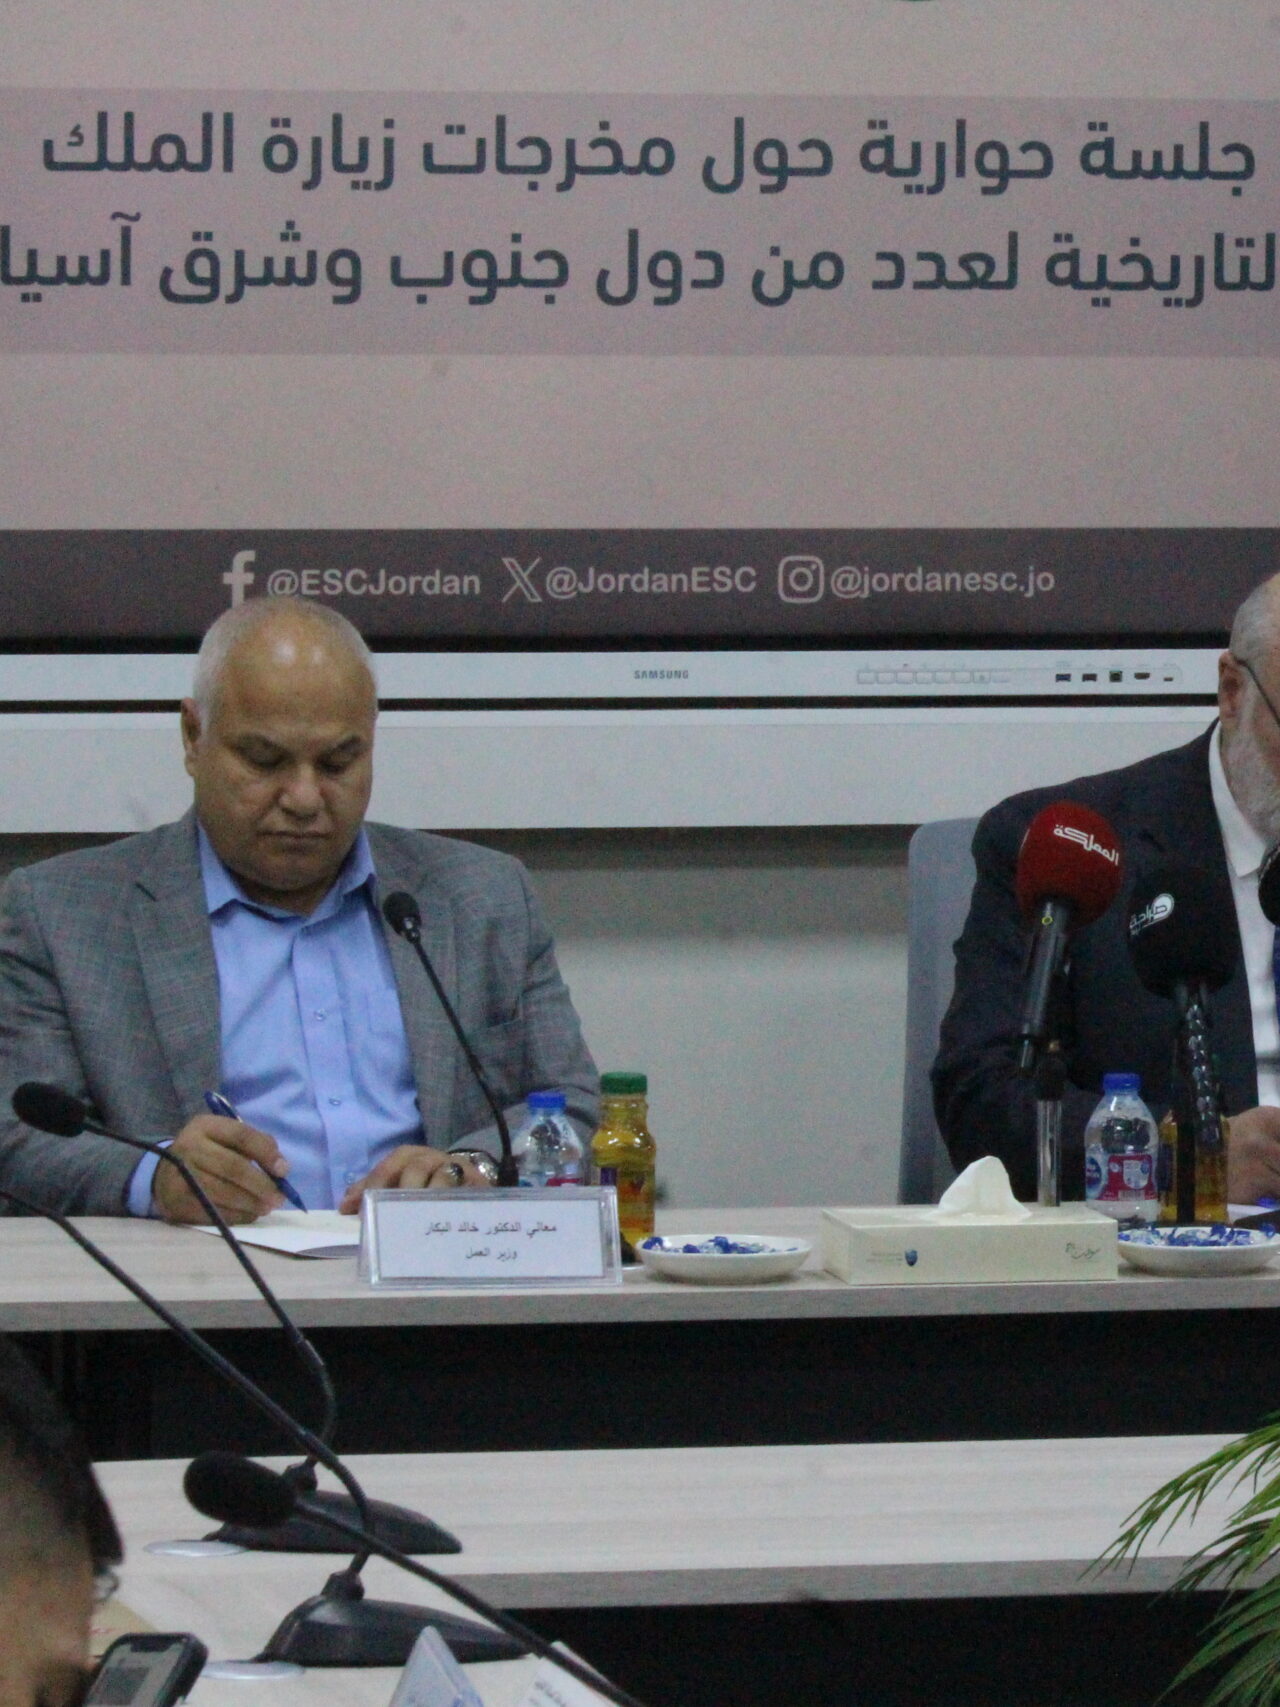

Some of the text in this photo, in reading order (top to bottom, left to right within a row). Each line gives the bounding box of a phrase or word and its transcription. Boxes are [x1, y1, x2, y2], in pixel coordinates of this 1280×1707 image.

[42, 110, 1256, 197] جلسة حوارية حول مخرجات زيارة الملك
[0, 211, 141, 303] آسيا
[158, 220, 362, 305] وشرق
[390, 232, 570, 306] جنوب
[595, 228, 725, 307] دول
[751, 246, 845, 308] من
[871, 230, 1019, 291] لعدد
[266, 567, 482, 599] @ESCJordan
[545, 565, 758, 600] @JordanESC
[829, 565, 1056, 599] @jordanesc.jo
[633, 669, 689, 680] SAMSUNG
[1053, 823, 1120, 867] المملكة
[485, 1221, 522, 1236] الدكتور
[525, 1222, 558, 1239] معالي
